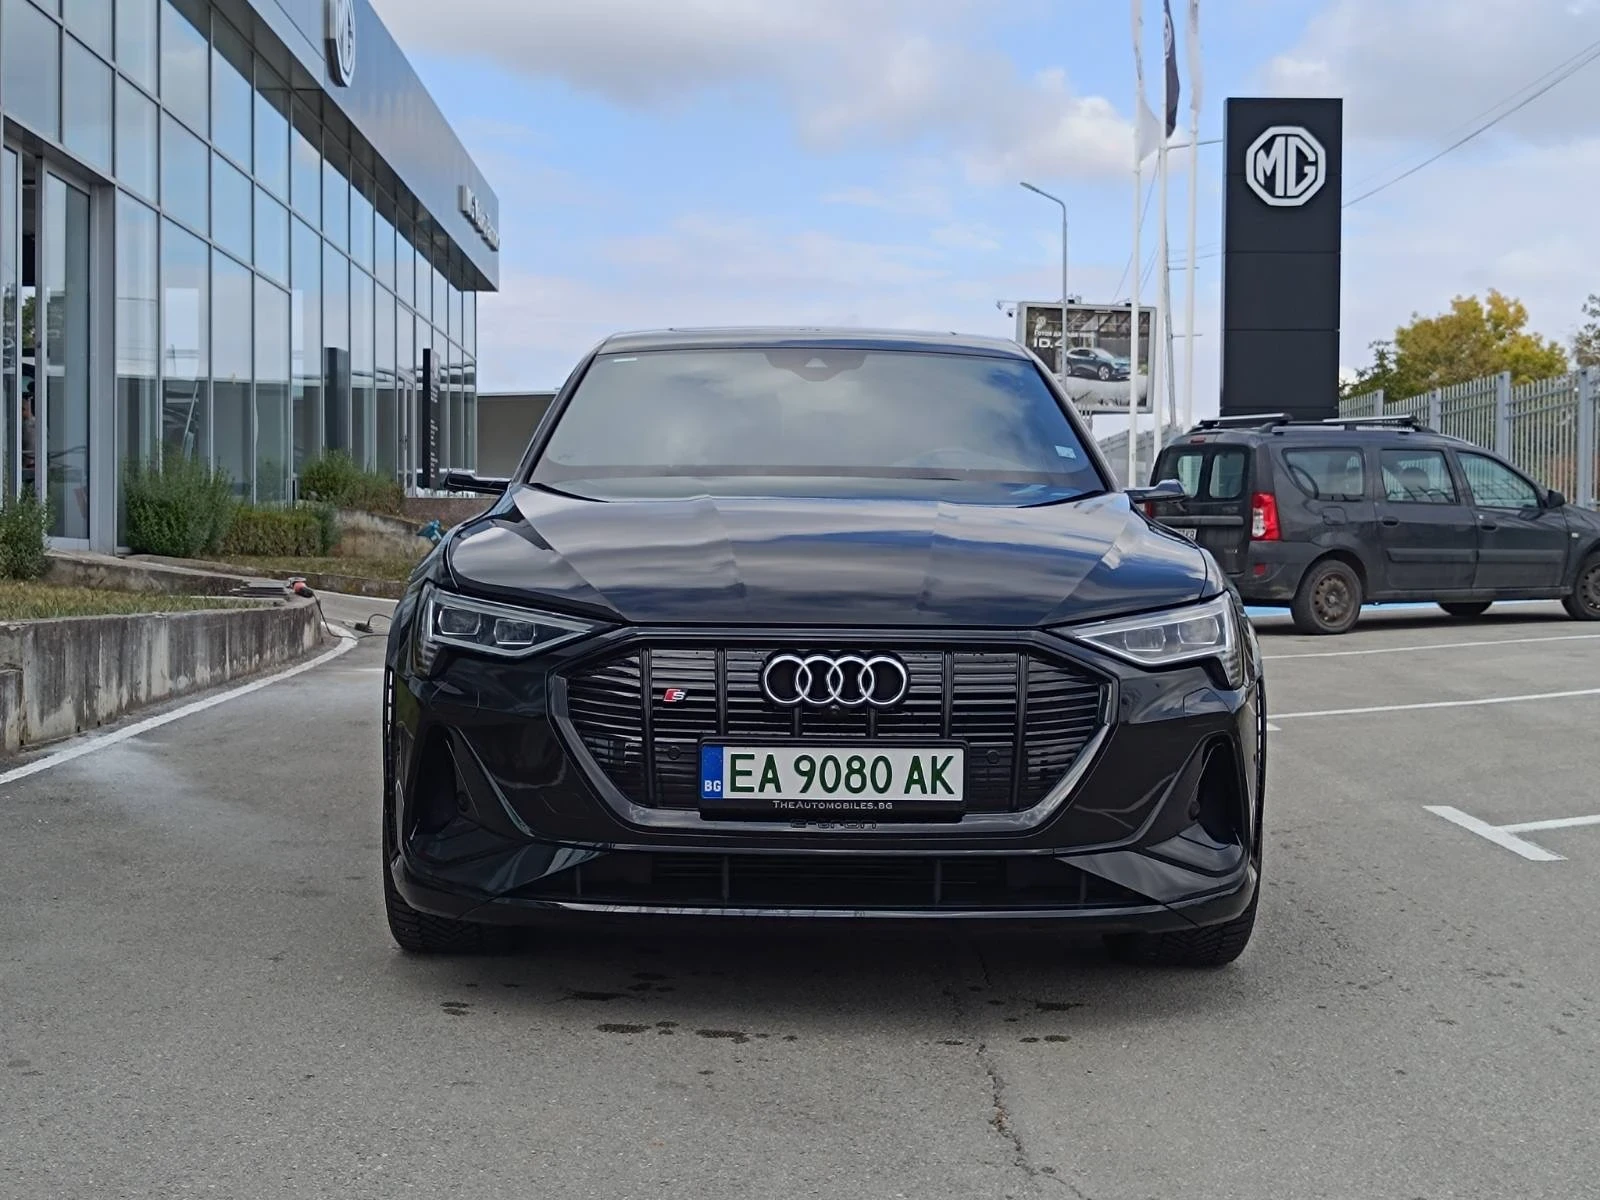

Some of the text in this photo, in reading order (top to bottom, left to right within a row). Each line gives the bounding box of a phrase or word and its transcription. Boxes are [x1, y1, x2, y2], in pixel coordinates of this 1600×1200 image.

[1253, 133, 1319, 201] MG
[704, 780, 722, 792] BG
[730, 753, 955, 795] EA 9080 AK
